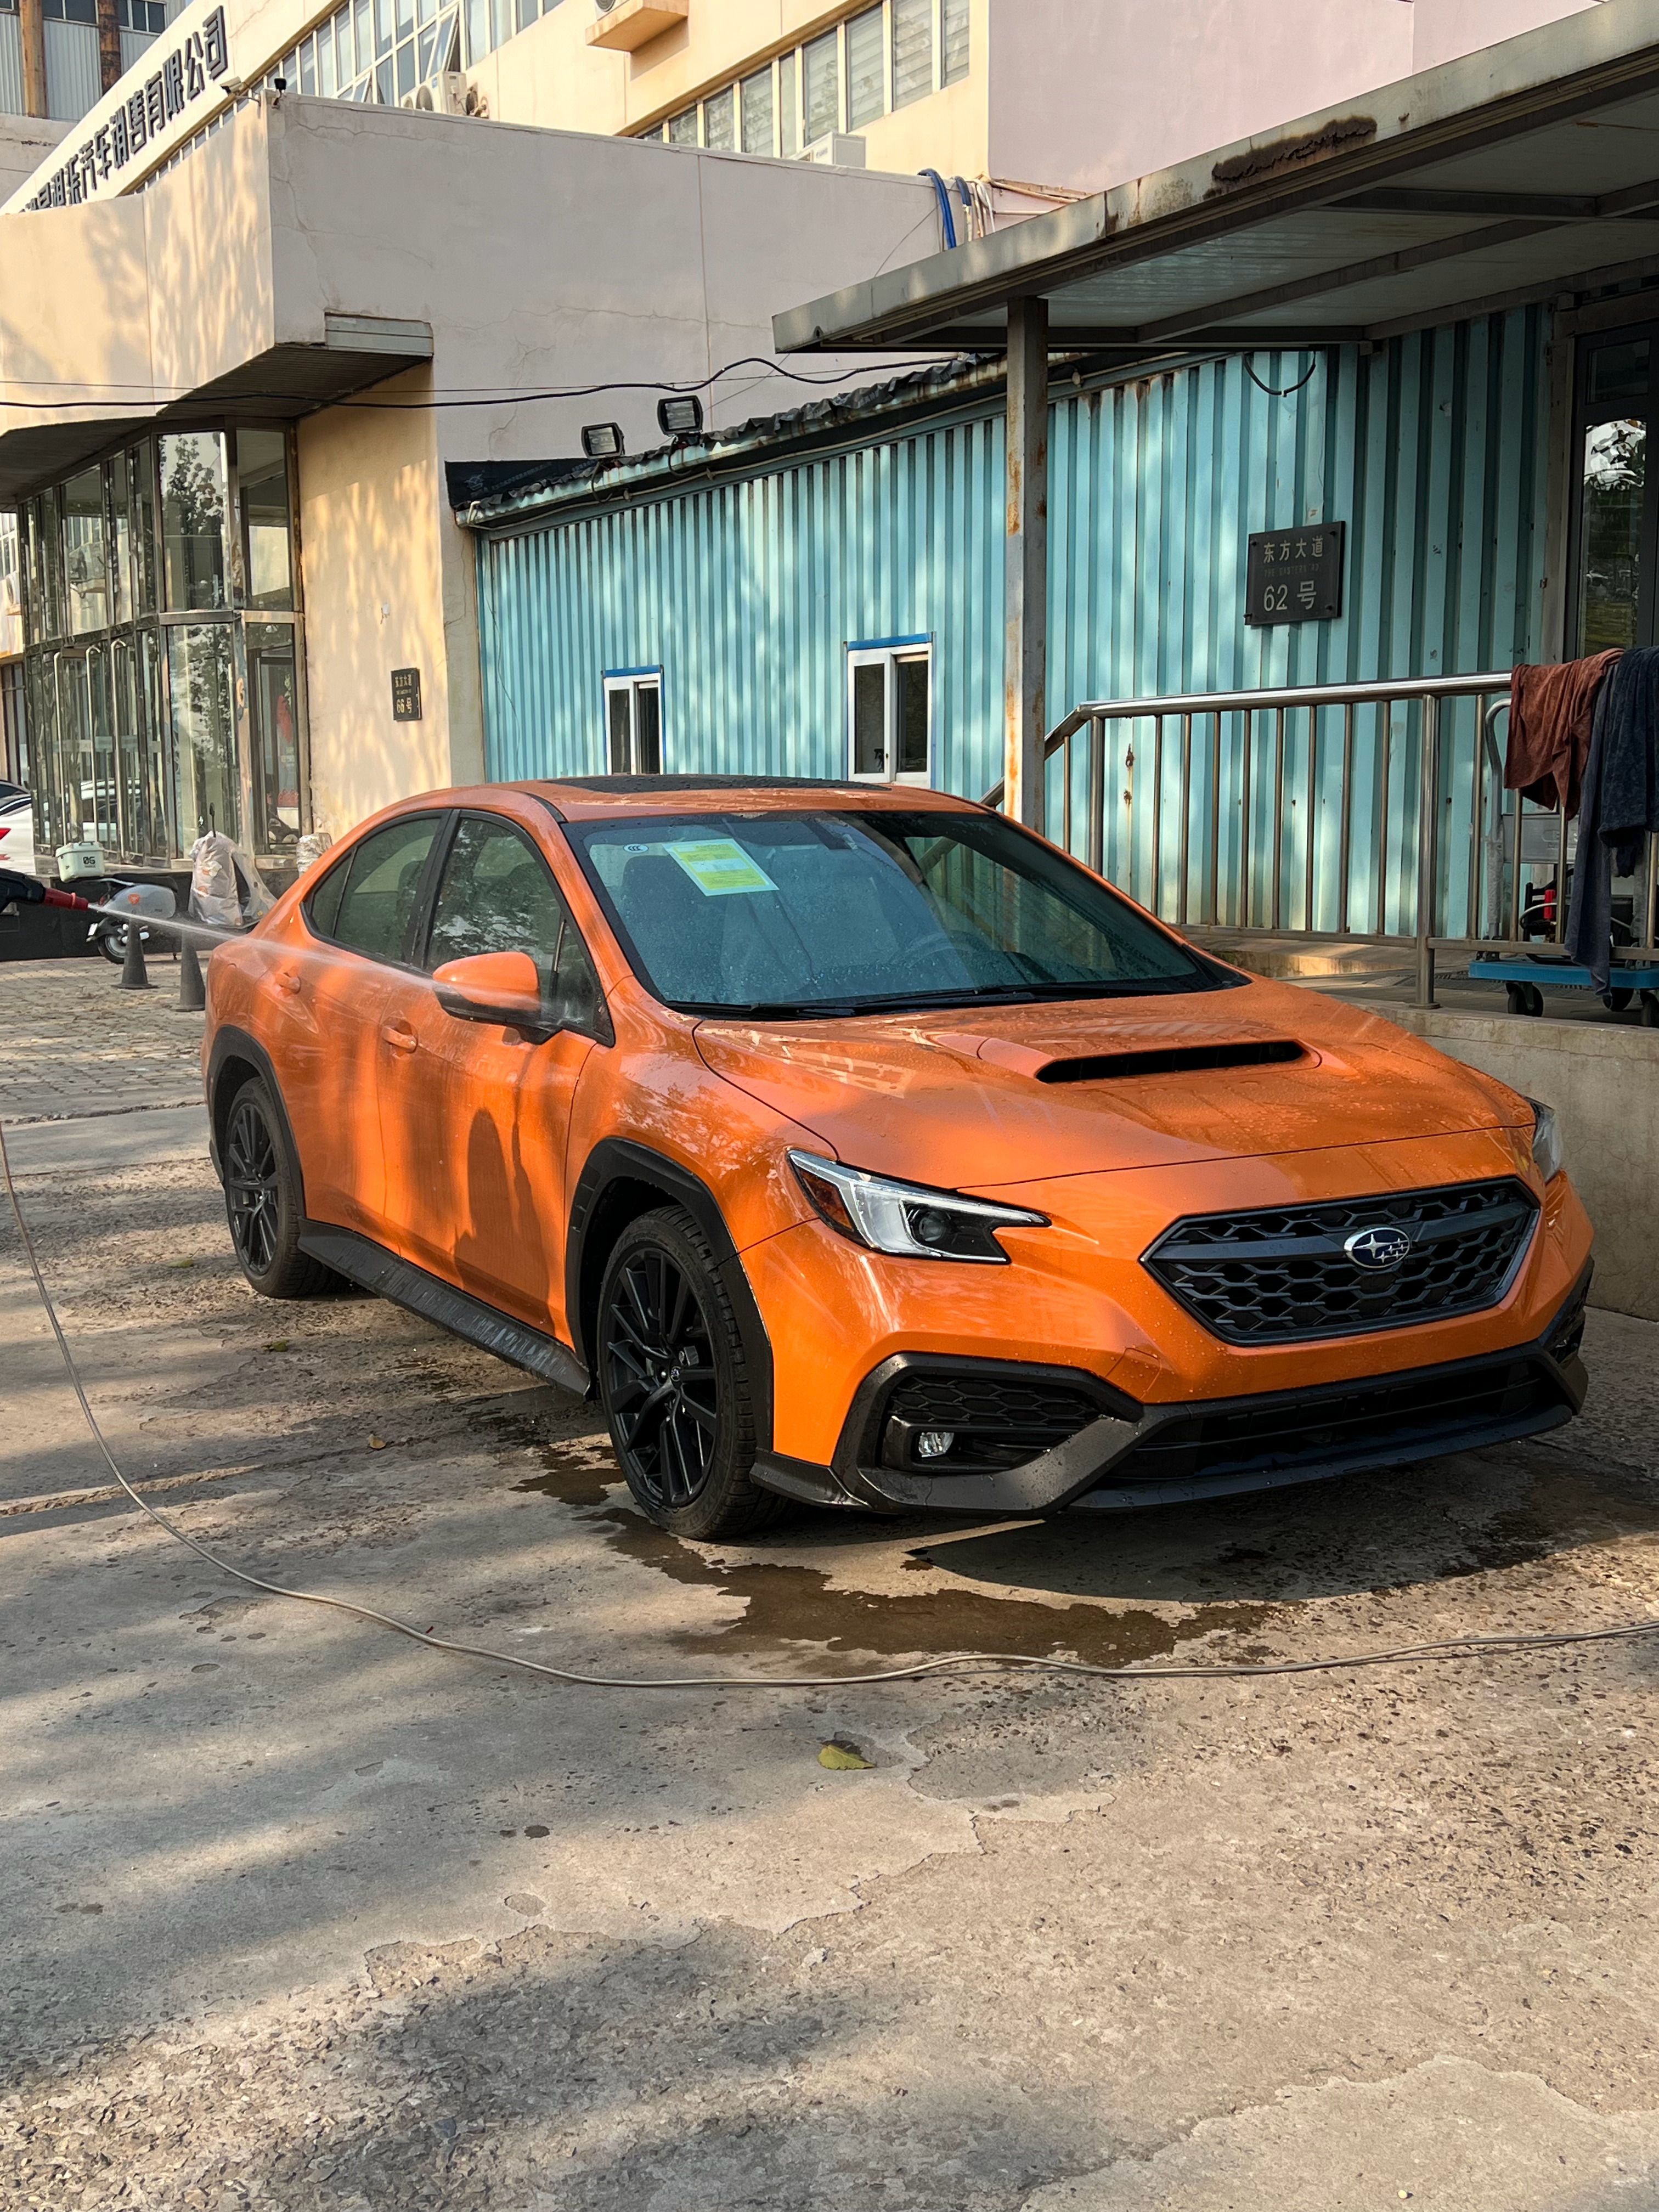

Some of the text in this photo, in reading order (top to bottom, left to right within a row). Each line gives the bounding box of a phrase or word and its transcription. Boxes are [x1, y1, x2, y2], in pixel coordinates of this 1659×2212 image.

[20, 5, 228, 213] 汽车销售有限公司
[1263, 535, 1323, 563] 东方大道
[1263, 580, 1317, 612] 62号
